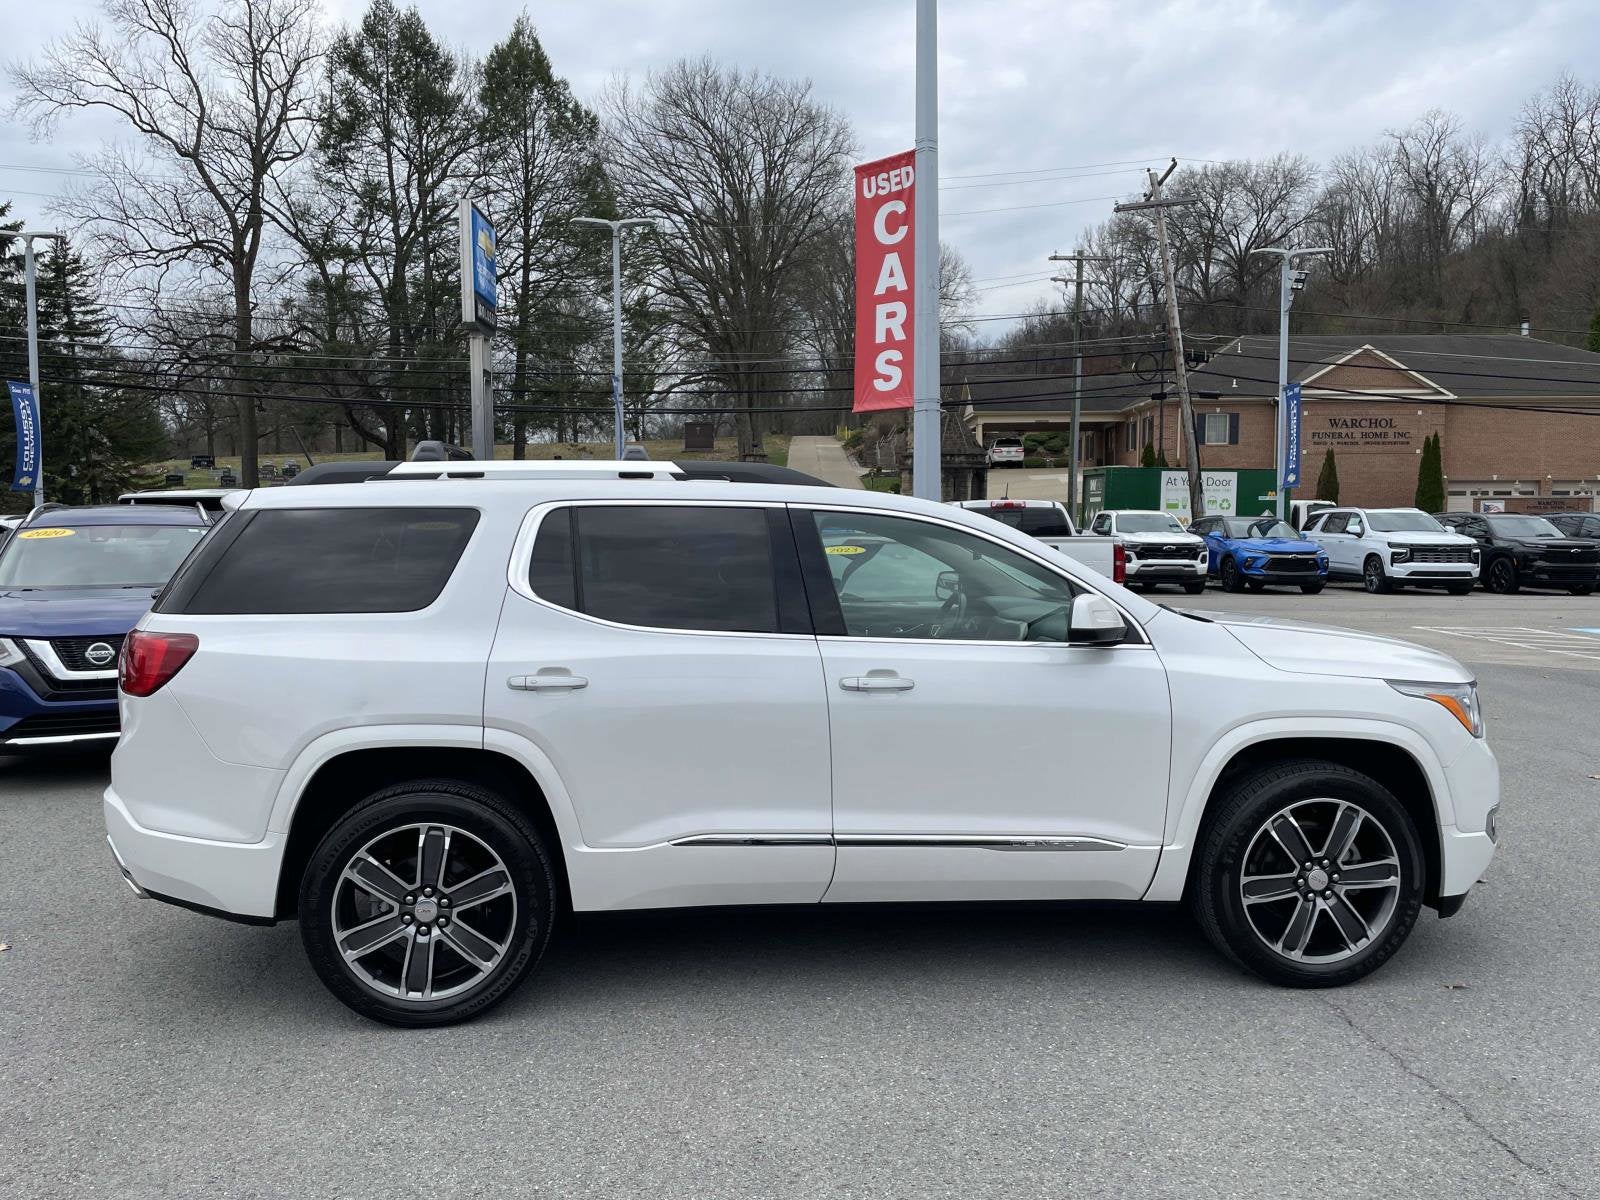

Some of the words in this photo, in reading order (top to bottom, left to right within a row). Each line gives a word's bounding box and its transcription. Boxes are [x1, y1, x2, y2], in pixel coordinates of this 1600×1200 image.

[863, 165, 915, 199] USED
[873, 200, 909, 392] CARS
[18, 397, 30, 472] COLUSSY
[24, 399, 35, 471] CHEVROLET
[1329, 418, 1397, 428] WARCHOL
[1166, 477, 1177, 486] At
[1206, 477, 1232, 486] Door
[27, 529, 67, 537] 2020
[468, 953, 528, 1008] DESTINATION
